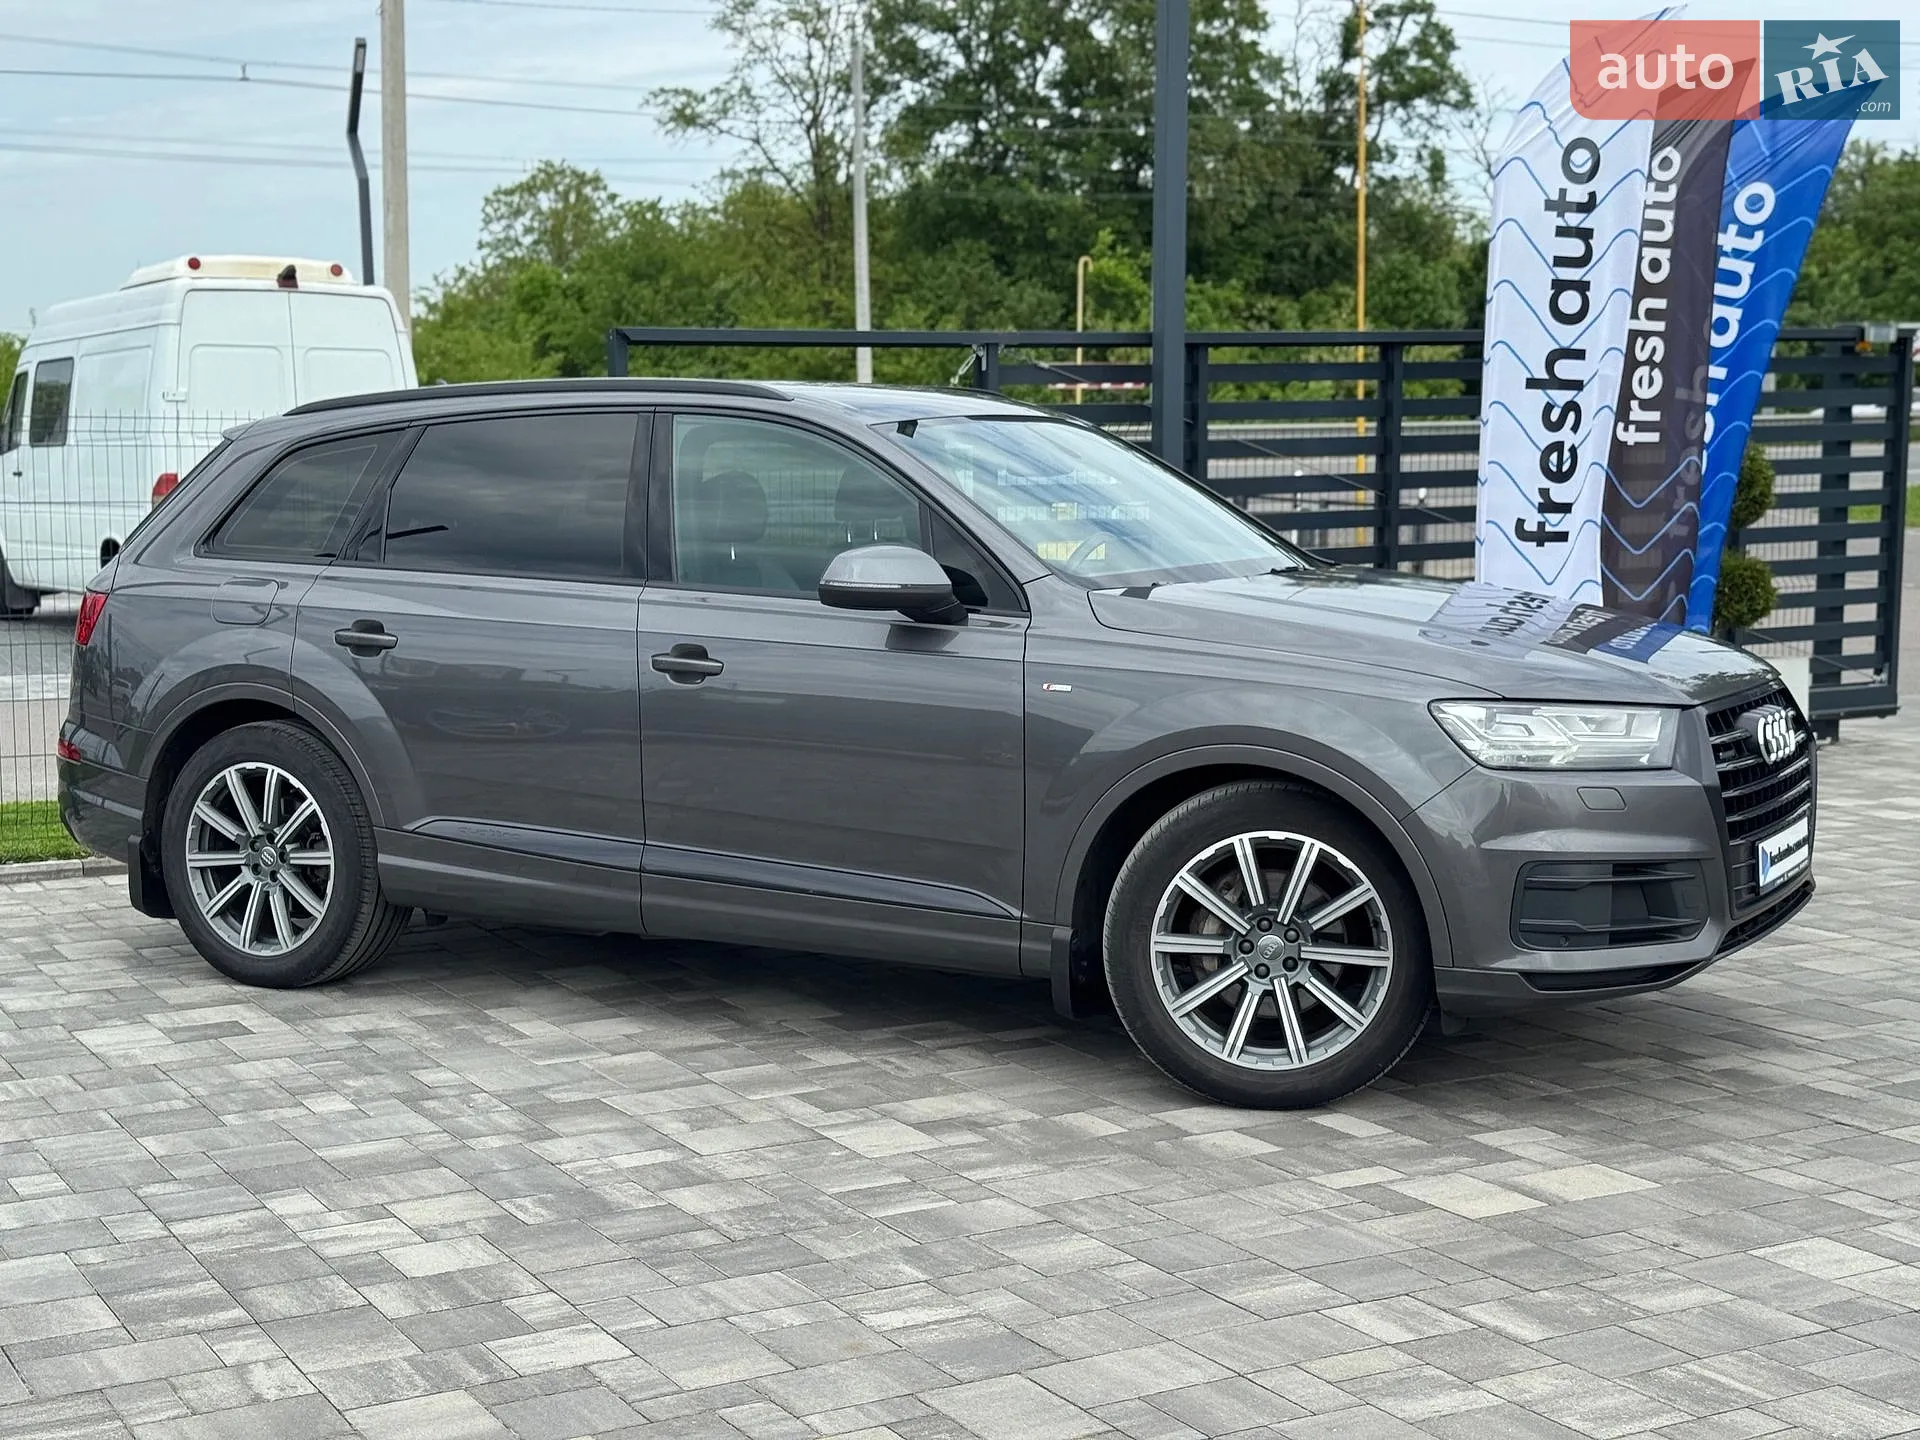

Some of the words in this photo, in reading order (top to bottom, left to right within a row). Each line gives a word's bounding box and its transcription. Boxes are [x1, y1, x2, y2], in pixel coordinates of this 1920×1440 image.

[1543, 136, 1601, 326] auto
[1640, 145, 1682, 284] auto
[1709, 181, 1776, 348] auto
[1515, 347, 1587, 547] fresh
[1615, 297, 1668, 446] fresh
